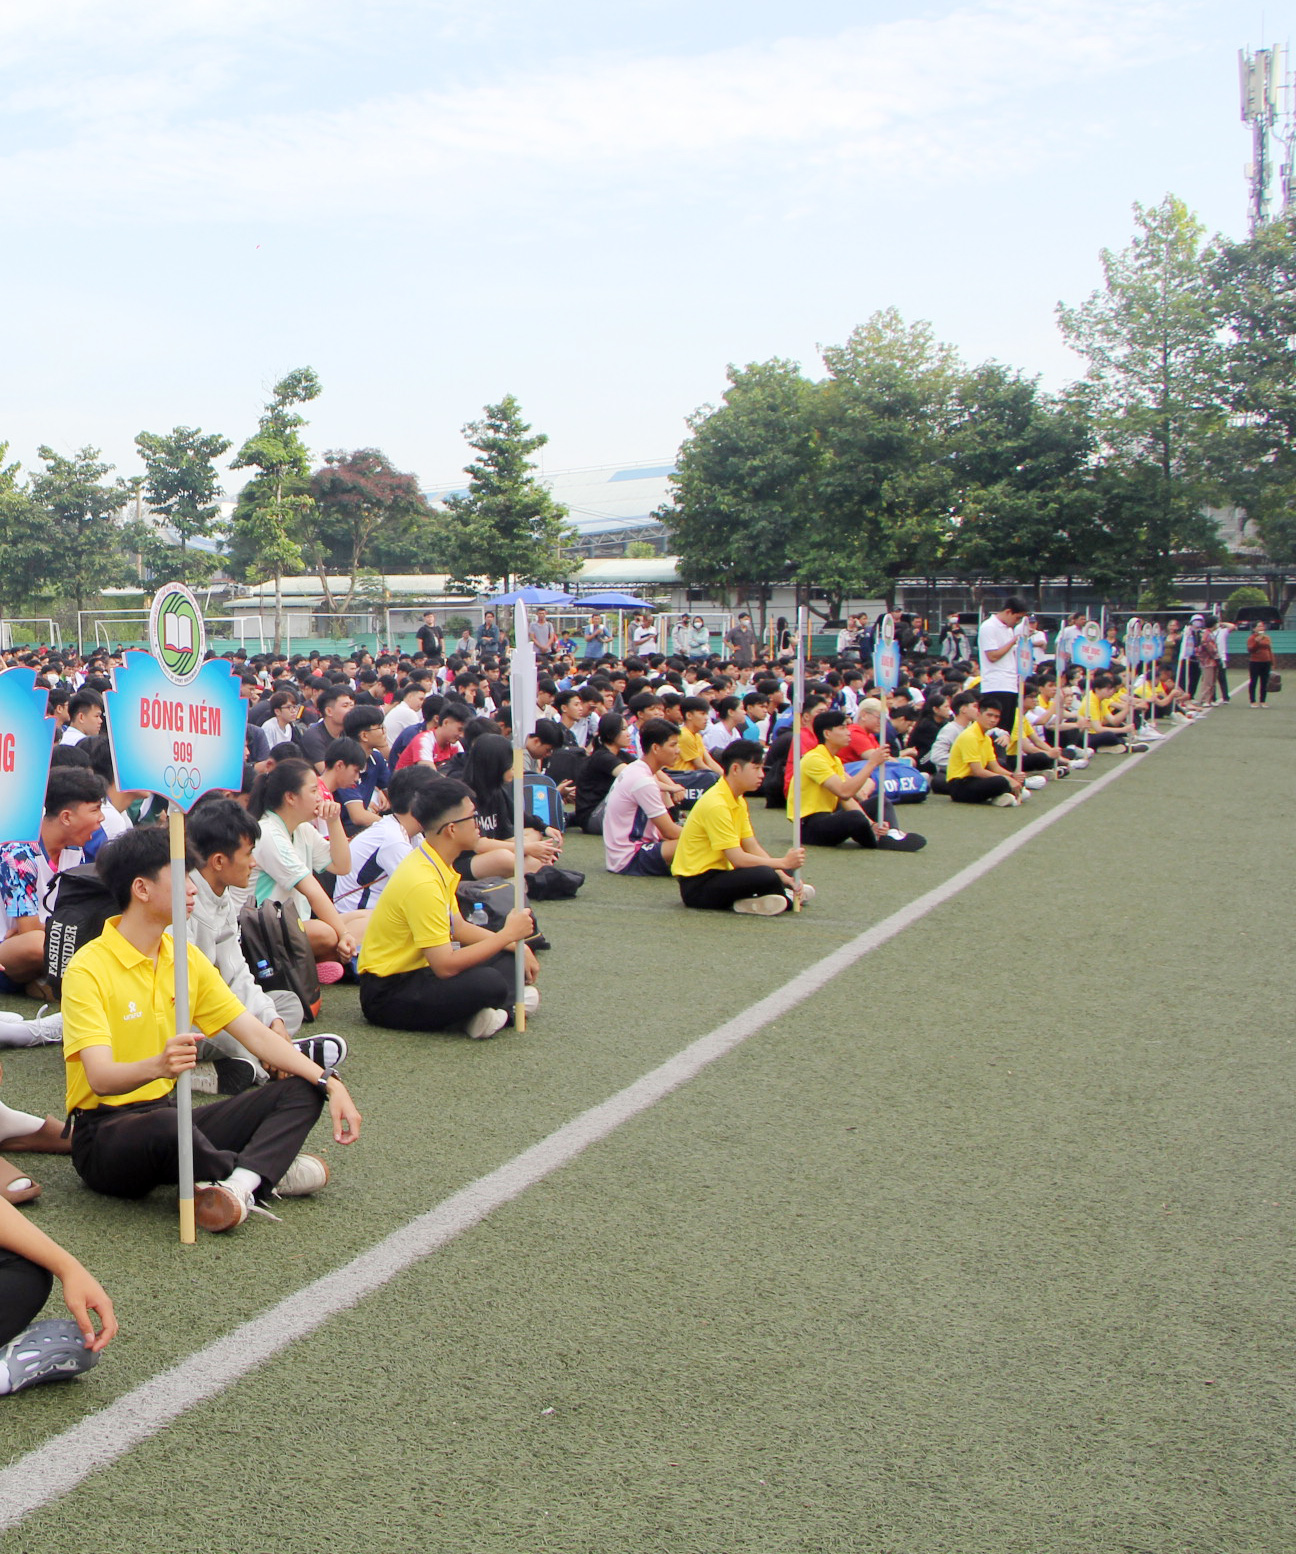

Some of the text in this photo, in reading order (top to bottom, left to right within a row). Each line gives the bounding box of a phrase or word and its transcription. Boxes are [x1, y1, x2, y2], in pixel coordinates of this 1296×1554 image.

[140, 693, 221, 736] BÓNG NÉM
[173, 741, 193, 763] 909
[49, 920, 63, 977] FASHION
